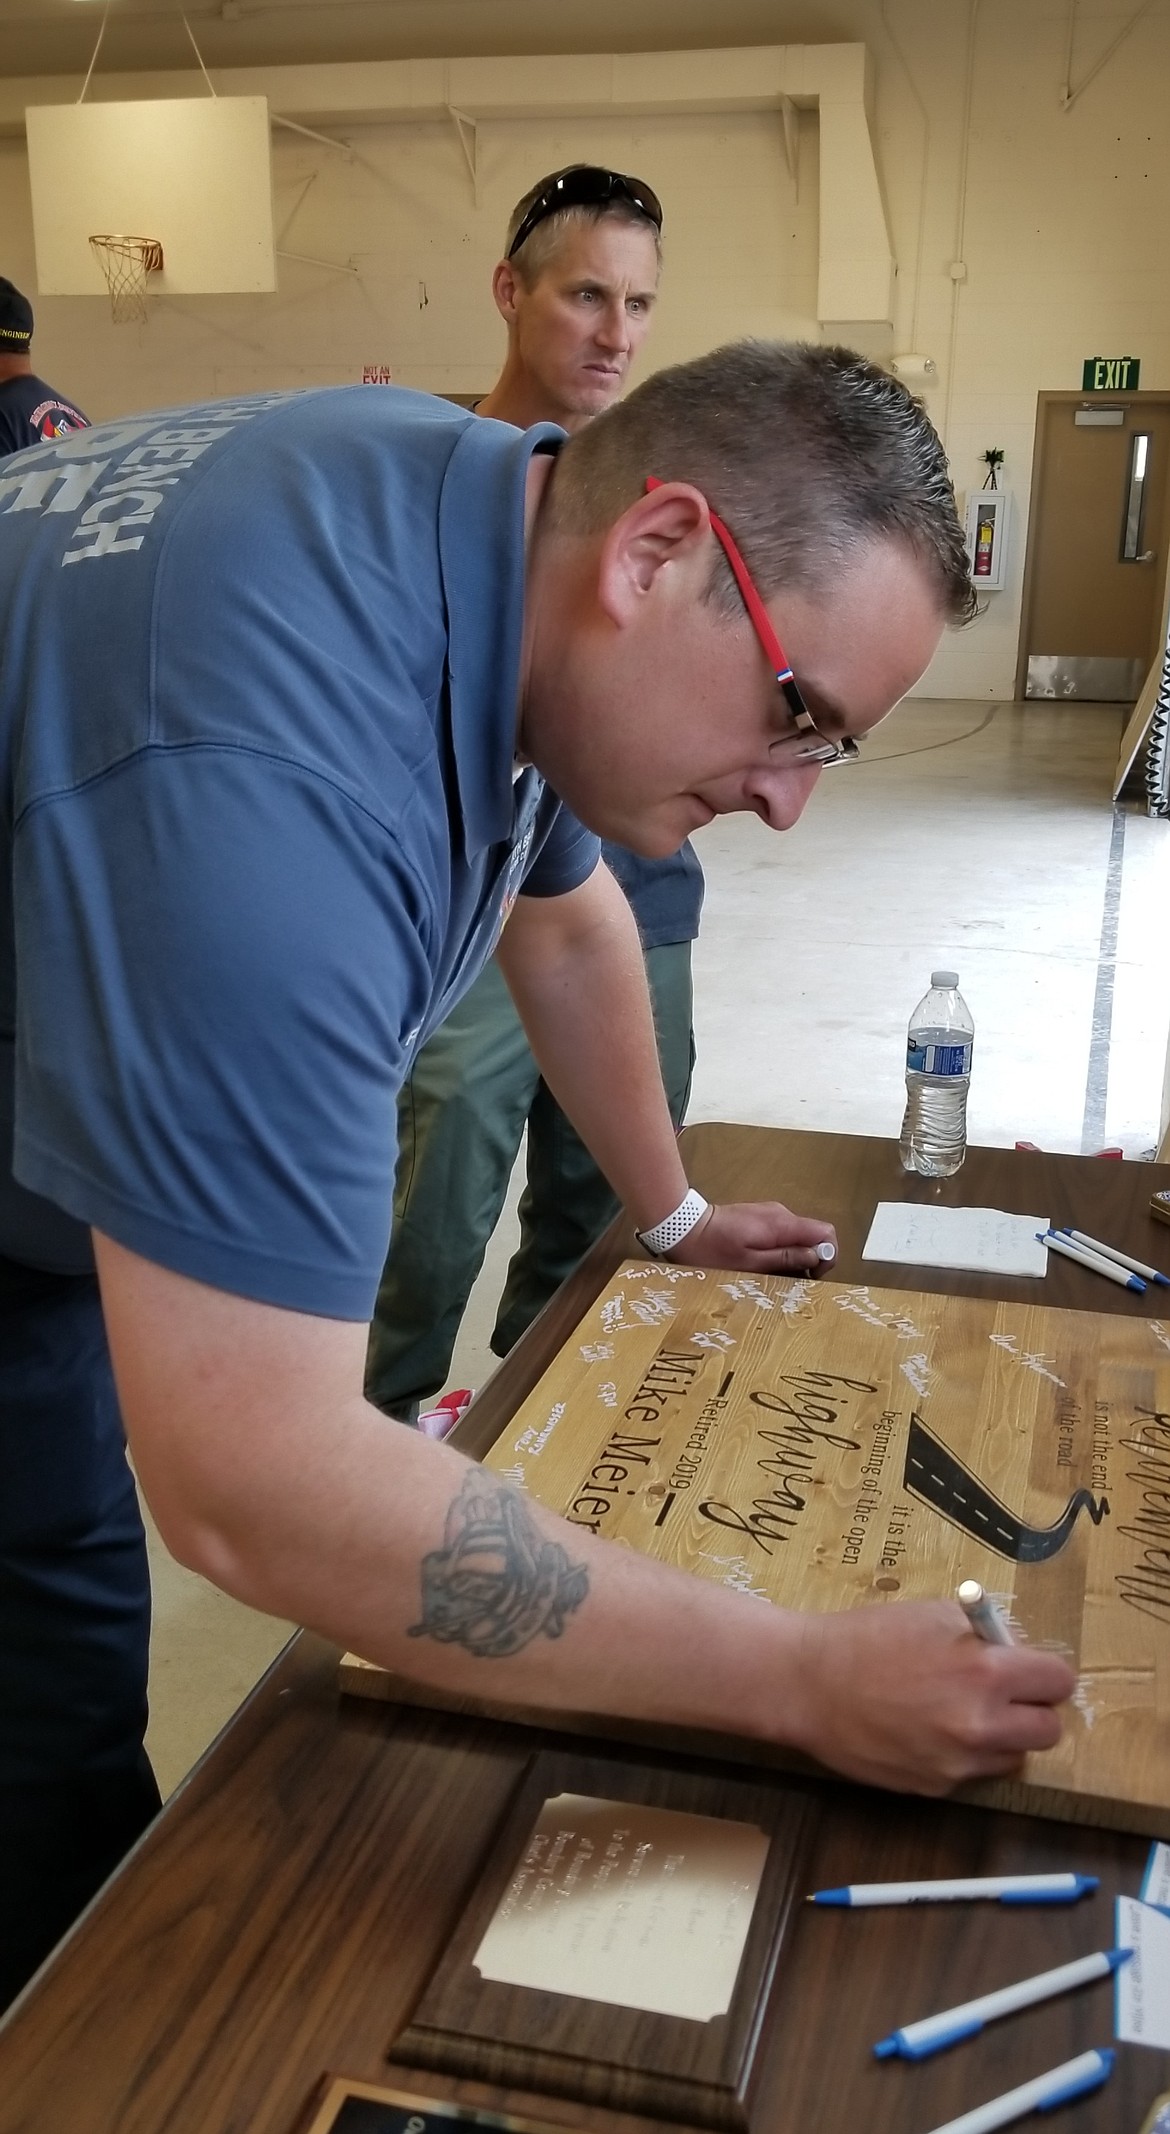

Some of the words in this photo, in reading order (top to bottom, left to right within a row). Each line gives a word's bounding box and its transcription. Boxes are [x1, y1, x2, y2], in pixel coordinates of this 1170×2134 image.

[364, 366, 378, 375] NOT
[380, 366, 390, 375] AN
[1094, 361, 1131, 389] EXIT
[62, 426, 236, 567] BENCH
[624, 1348, 705, 1423] Mike
[1060, 1397, 1081, 1410] of
[1095, 1401, 1114, 1412] is
[685, 1397, 729, 1453] Retired
[1059, 1413, 1080, 1434] the
[1093, 1415, 1112, 1435] not
[860, 1410, 903, 1477] beginning
[1056, 1436, 1078, 1468] road
[1092, 1440, 1114, 1461] the
[668, 1451, 702, 1491] 2019
[698, 1370, 878, 1555] highway
[566, 1431, 662, 1535] Meier
[861, 1479, 883, 1496] of
[1091, 1464, 1113, 1491] end
[853, 1498, 878, 1523] the
[891, 1505, 914, 1517] it
[887, 1521, 911, 1535] is
[841, 1526, 866, 1565] open
[881, 1540, 907, 1567] the
